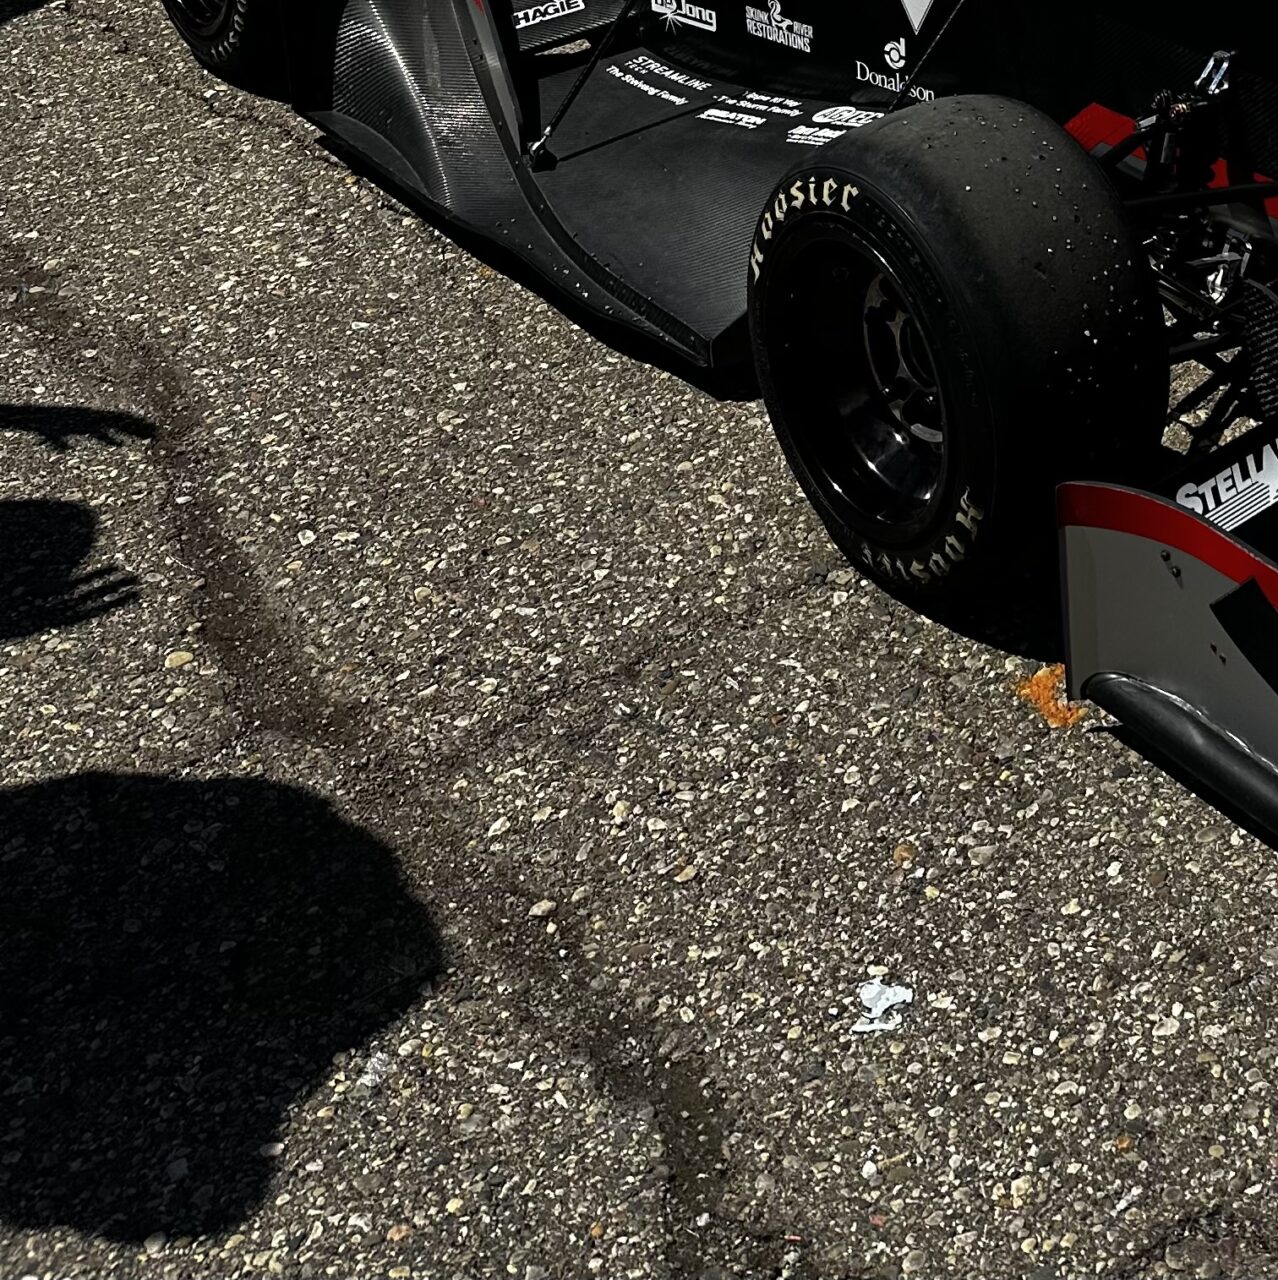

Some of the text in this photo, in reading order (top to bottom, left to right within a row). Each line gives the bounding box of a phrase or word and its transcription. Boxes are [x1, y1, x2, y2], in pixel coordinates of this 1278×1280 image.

[746, 18, 811, 53] RESTORATIONS
[793, 21, 813, 39] RIVER
[633, 55, 713, 91] STREAMLINE
[749, 175, 860, 286] Hoosier
